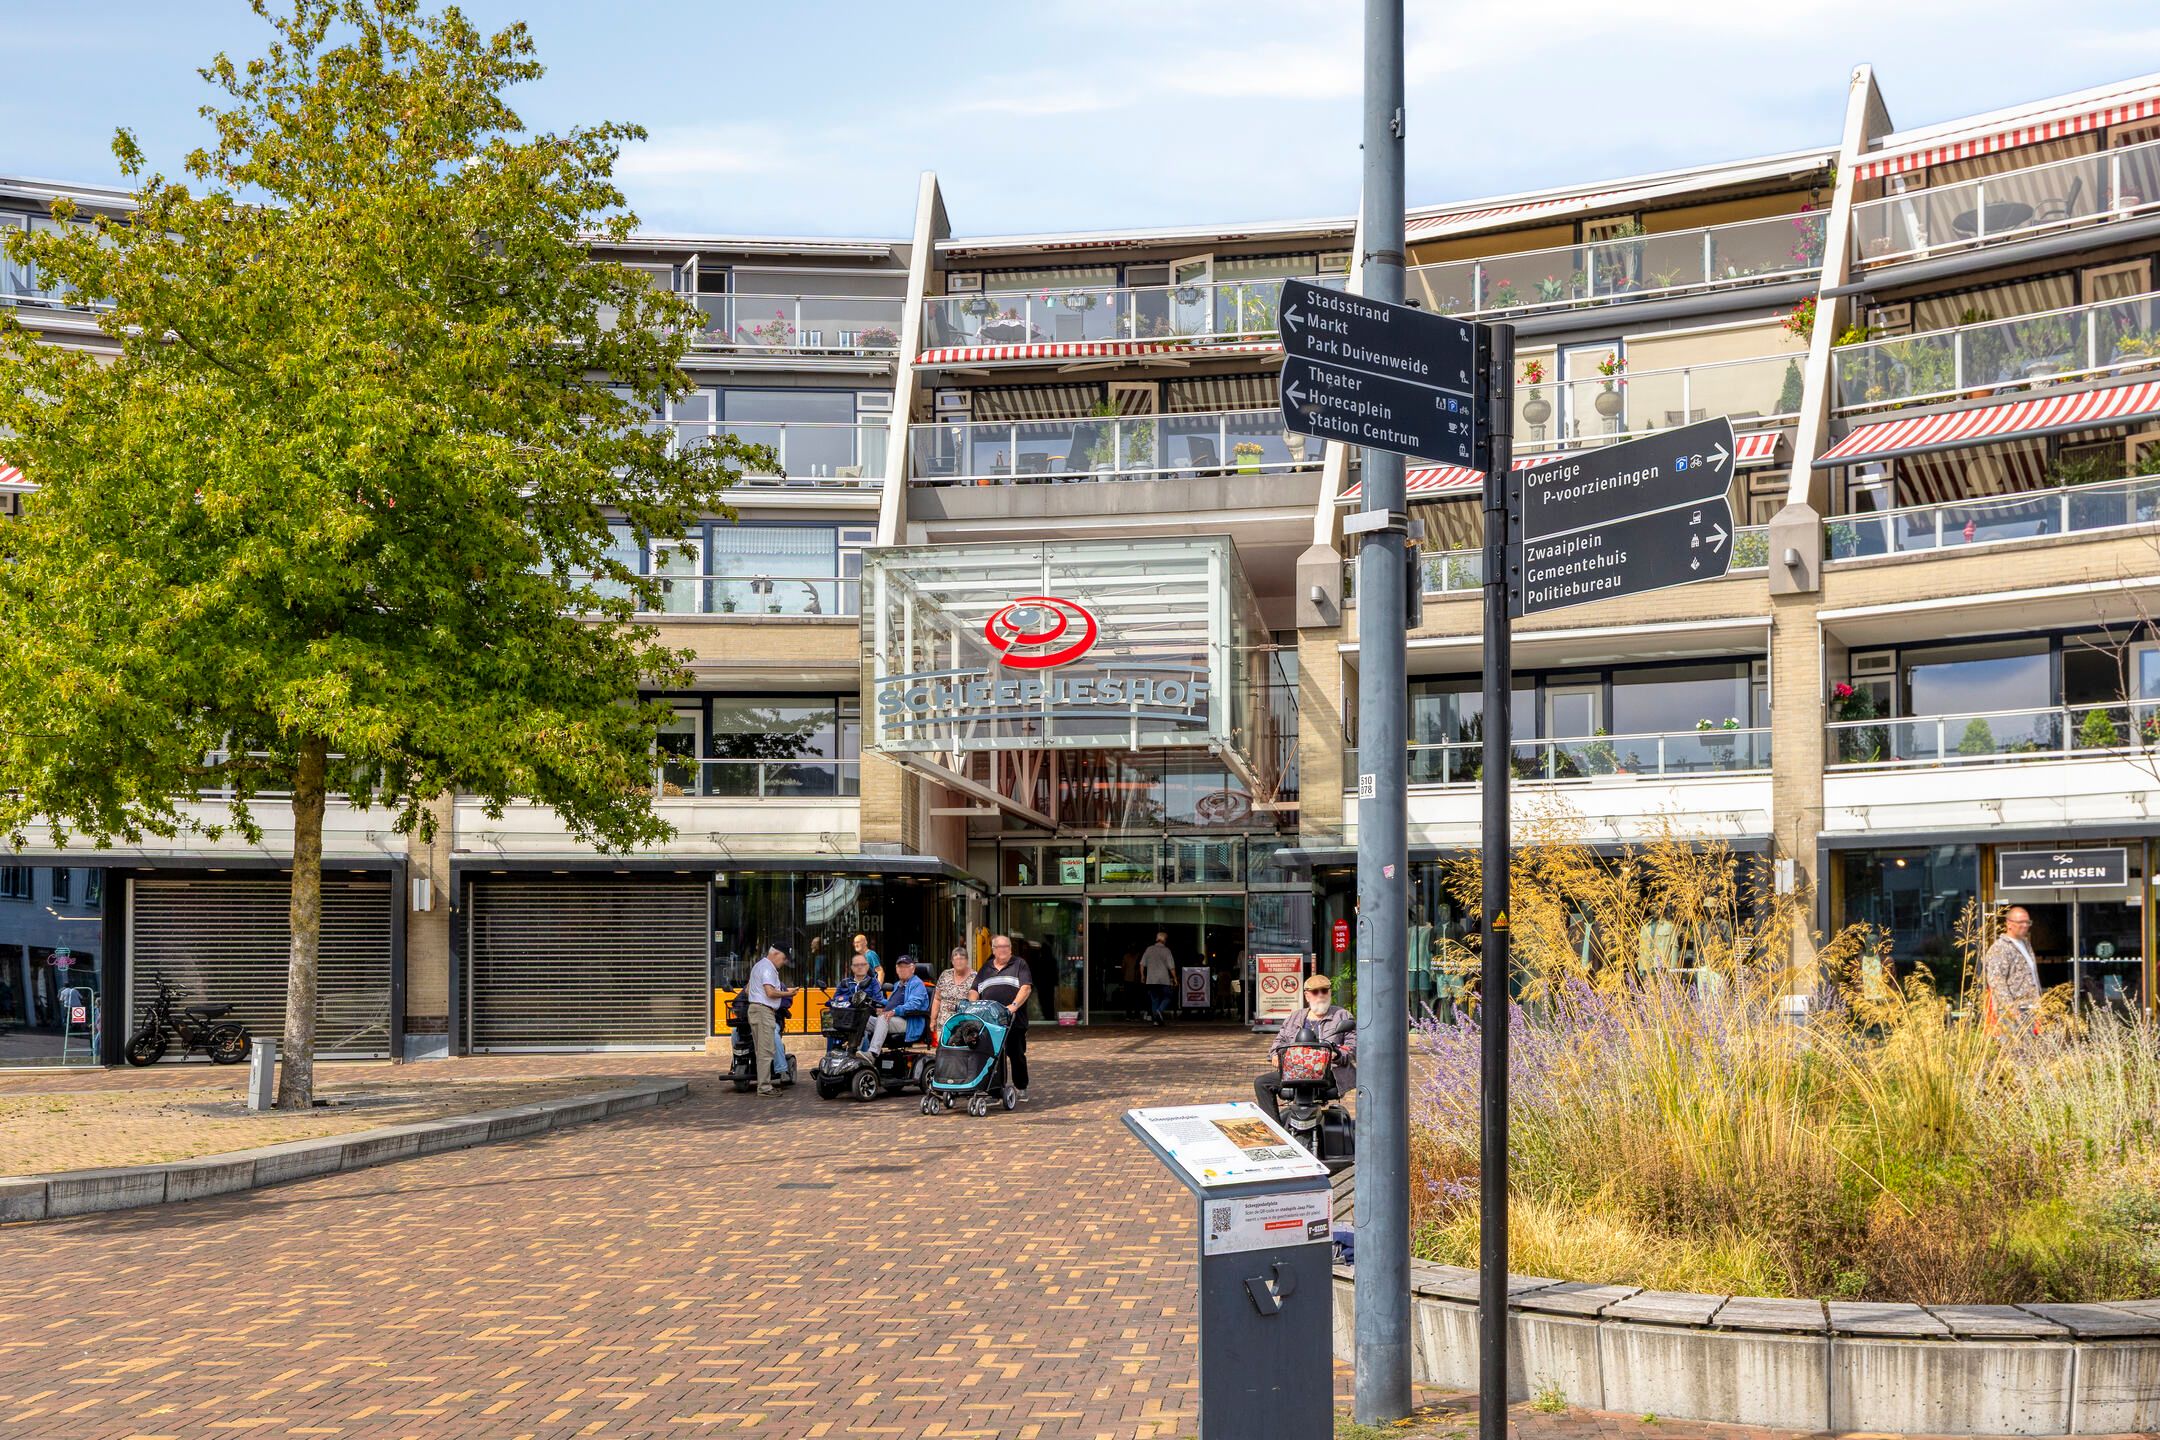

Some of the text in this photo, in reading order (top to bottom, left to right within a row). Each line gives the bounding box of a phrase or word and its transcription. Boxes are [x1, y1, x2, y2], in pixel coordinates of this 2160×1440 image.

[1306, 290, 1390, 323] Stadsstrand
[1306, 311, 1349, 336] Markt
[1306, 335, 1429, 376] Park Duivenweide
[1308, 366, 1362, 391] Theater
[1309, 388, 1392, 420] Horecaplein
[1308, 410, 1420, 448] Station Centrum
[1527, 464, 1580, 488] Overige
[1543, 464, 1659, 505] P-voorzieningen
[1527, 533, 1602, 562] Zwaaiplein
[1527, 550, 1627, 583] Gemeentehuis
[1527, 573, 1622, 604] Politiebureau
[877, 677, 1212, 717] SCHEEPJESHOF
[2020, 867, 2106, 880] JAC HENSEN
